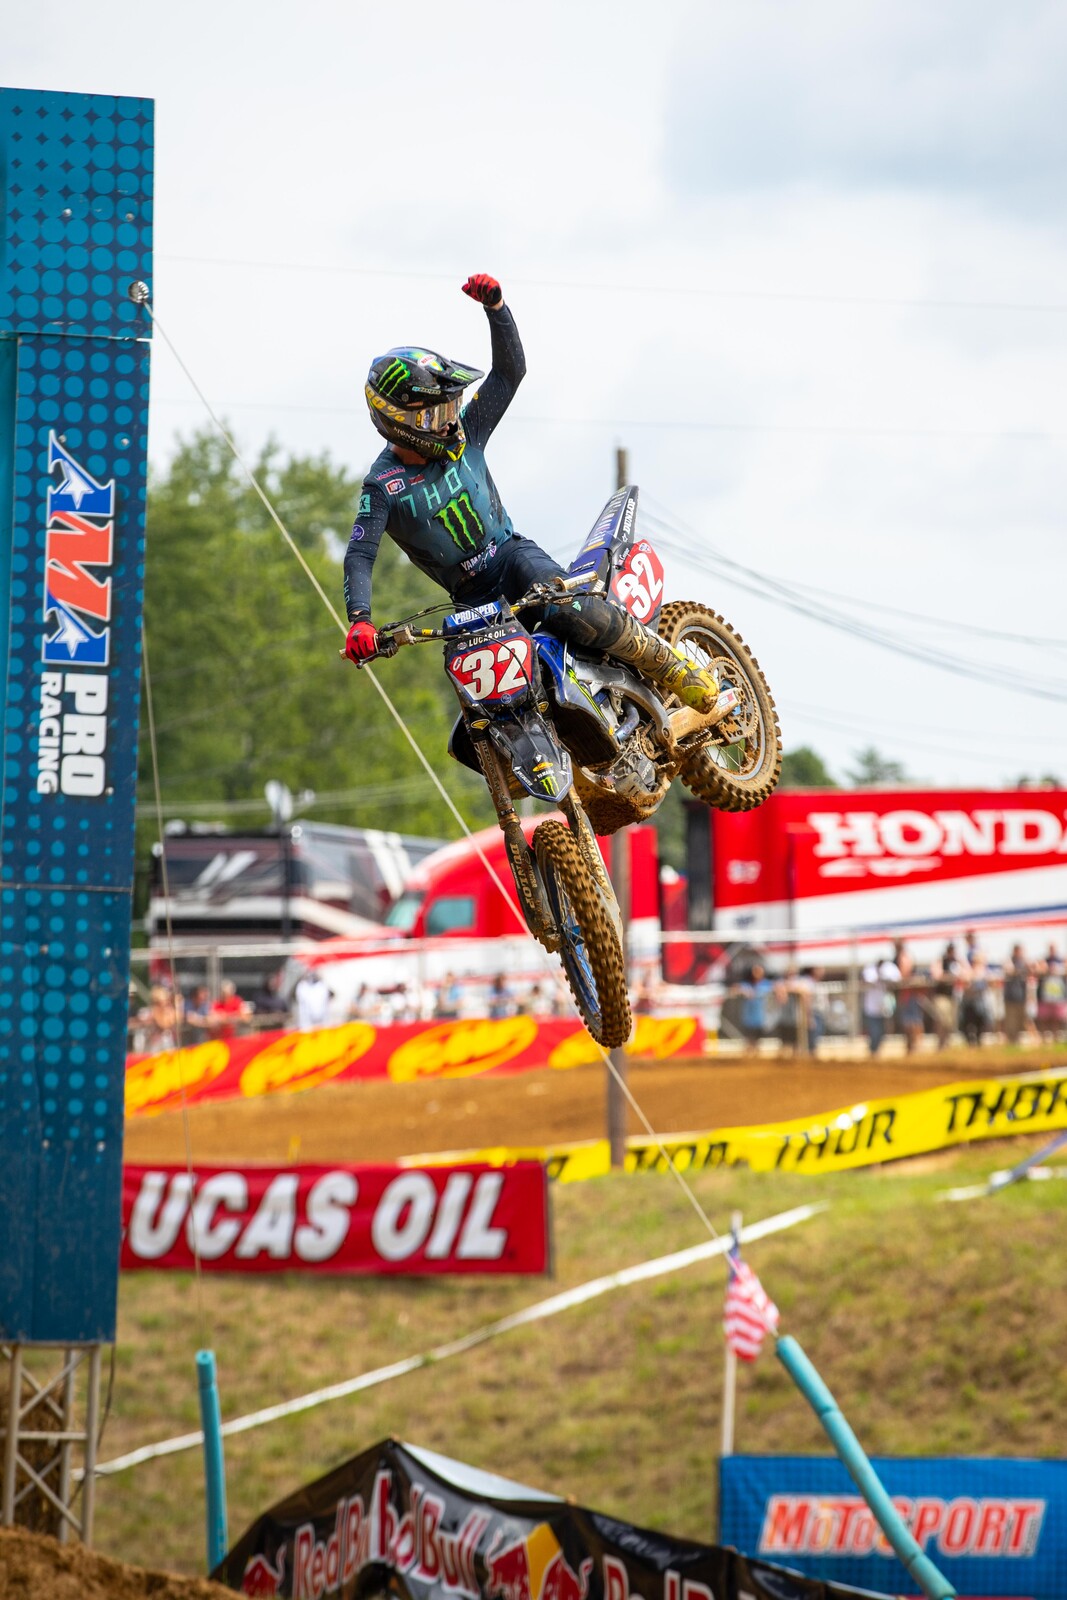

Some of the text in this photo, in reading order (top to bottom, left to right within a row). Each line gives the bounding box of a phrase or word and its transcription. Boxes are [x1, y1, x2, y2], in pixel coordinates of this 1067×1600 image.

[400, 454, 472, 518] THO
[622, 497, 636, 535] DUNLOP
[616, 552, 663, 619] 32
[461, 640, 528, 701] 32
[469, 629, 507, 648] LUCAS OIL
[37, 671, 63, 795] RACING
[61, 673, 108, 797] PRO
[806, 809, 1067, 857] HOND
[509, 843, 536, 909] DUNLOP
[775, 1108, 897, 1167] THOR
[127, 1170, 508, 1261] UCAS OIL
